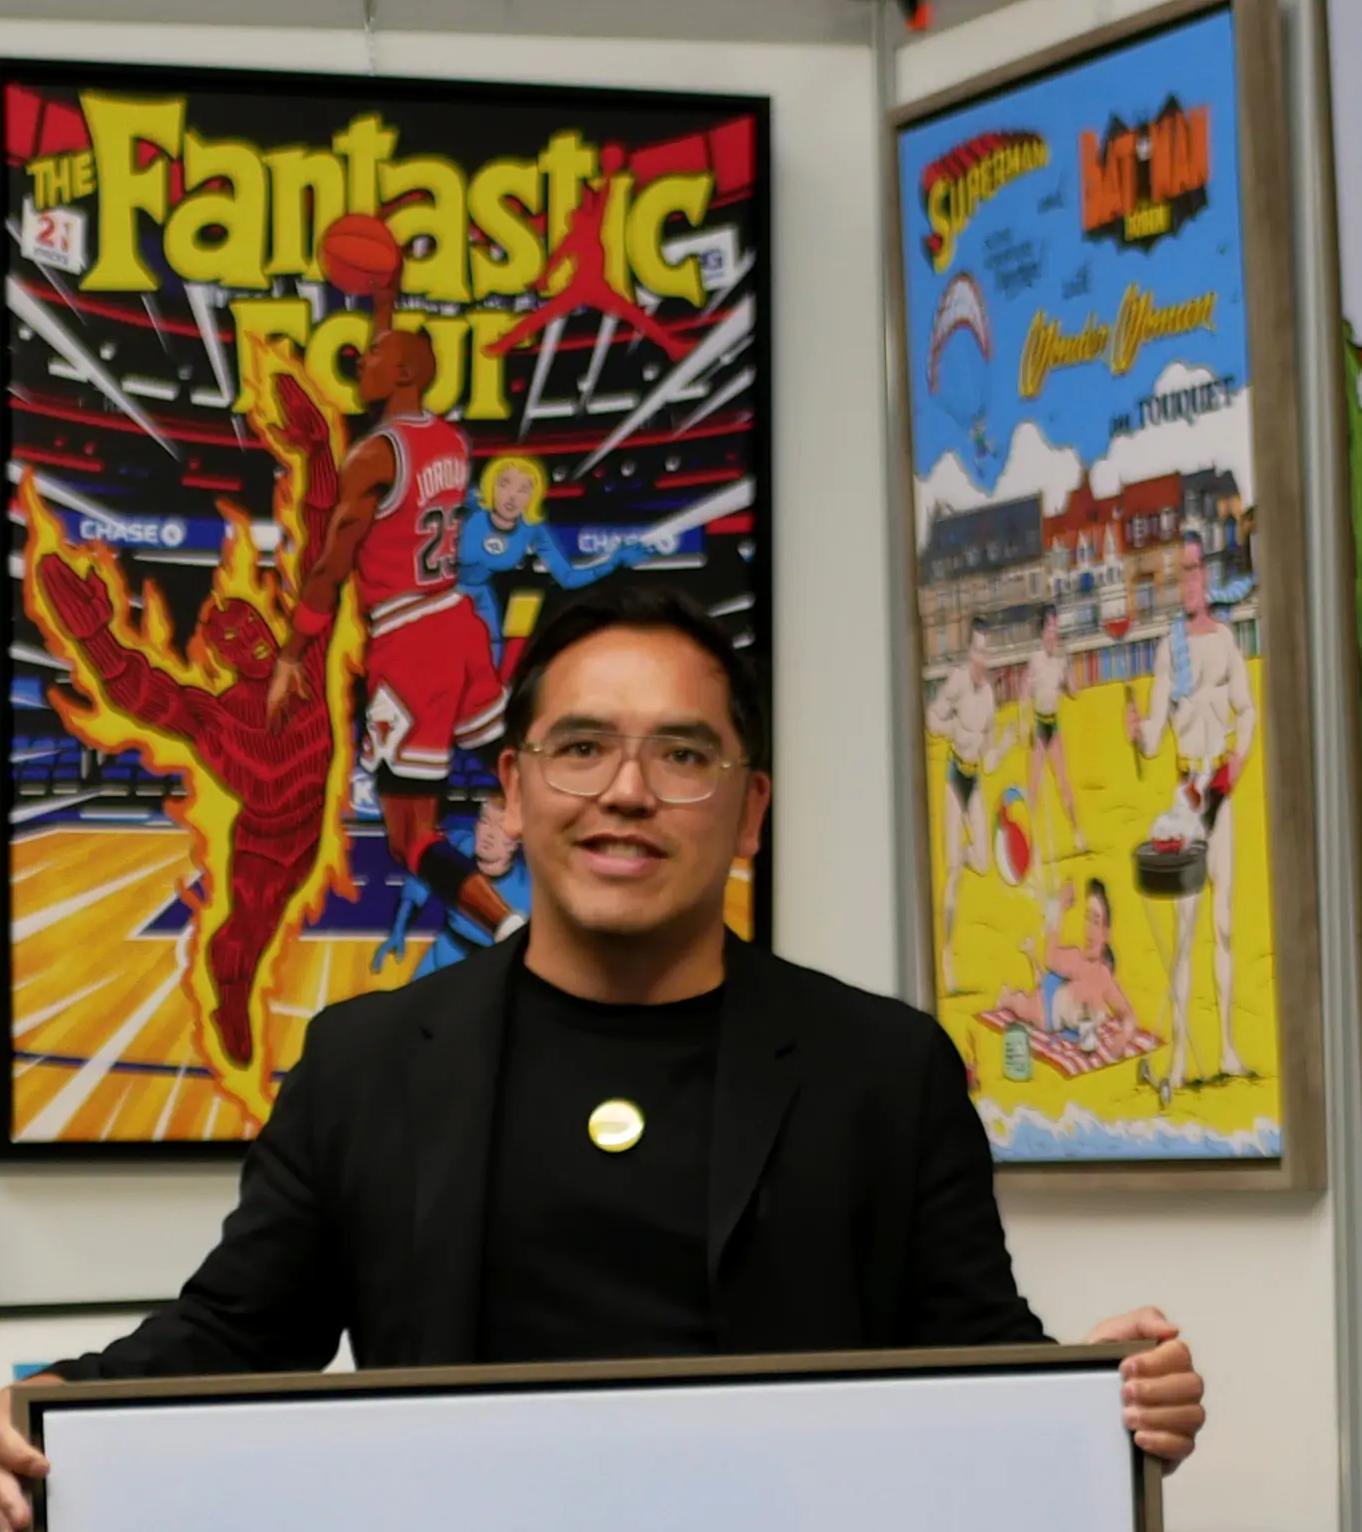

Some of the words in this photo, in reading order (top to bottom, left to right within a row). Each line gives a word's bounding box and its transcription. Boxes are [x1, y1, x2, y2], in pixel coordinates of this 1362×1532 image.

[26, 153, 97, 210] THE
[79, 88, 715, 309] Fantastic
[920, 129, 1050, 276] SUPERMAN
[79, 519, 159, 544] CHASE
